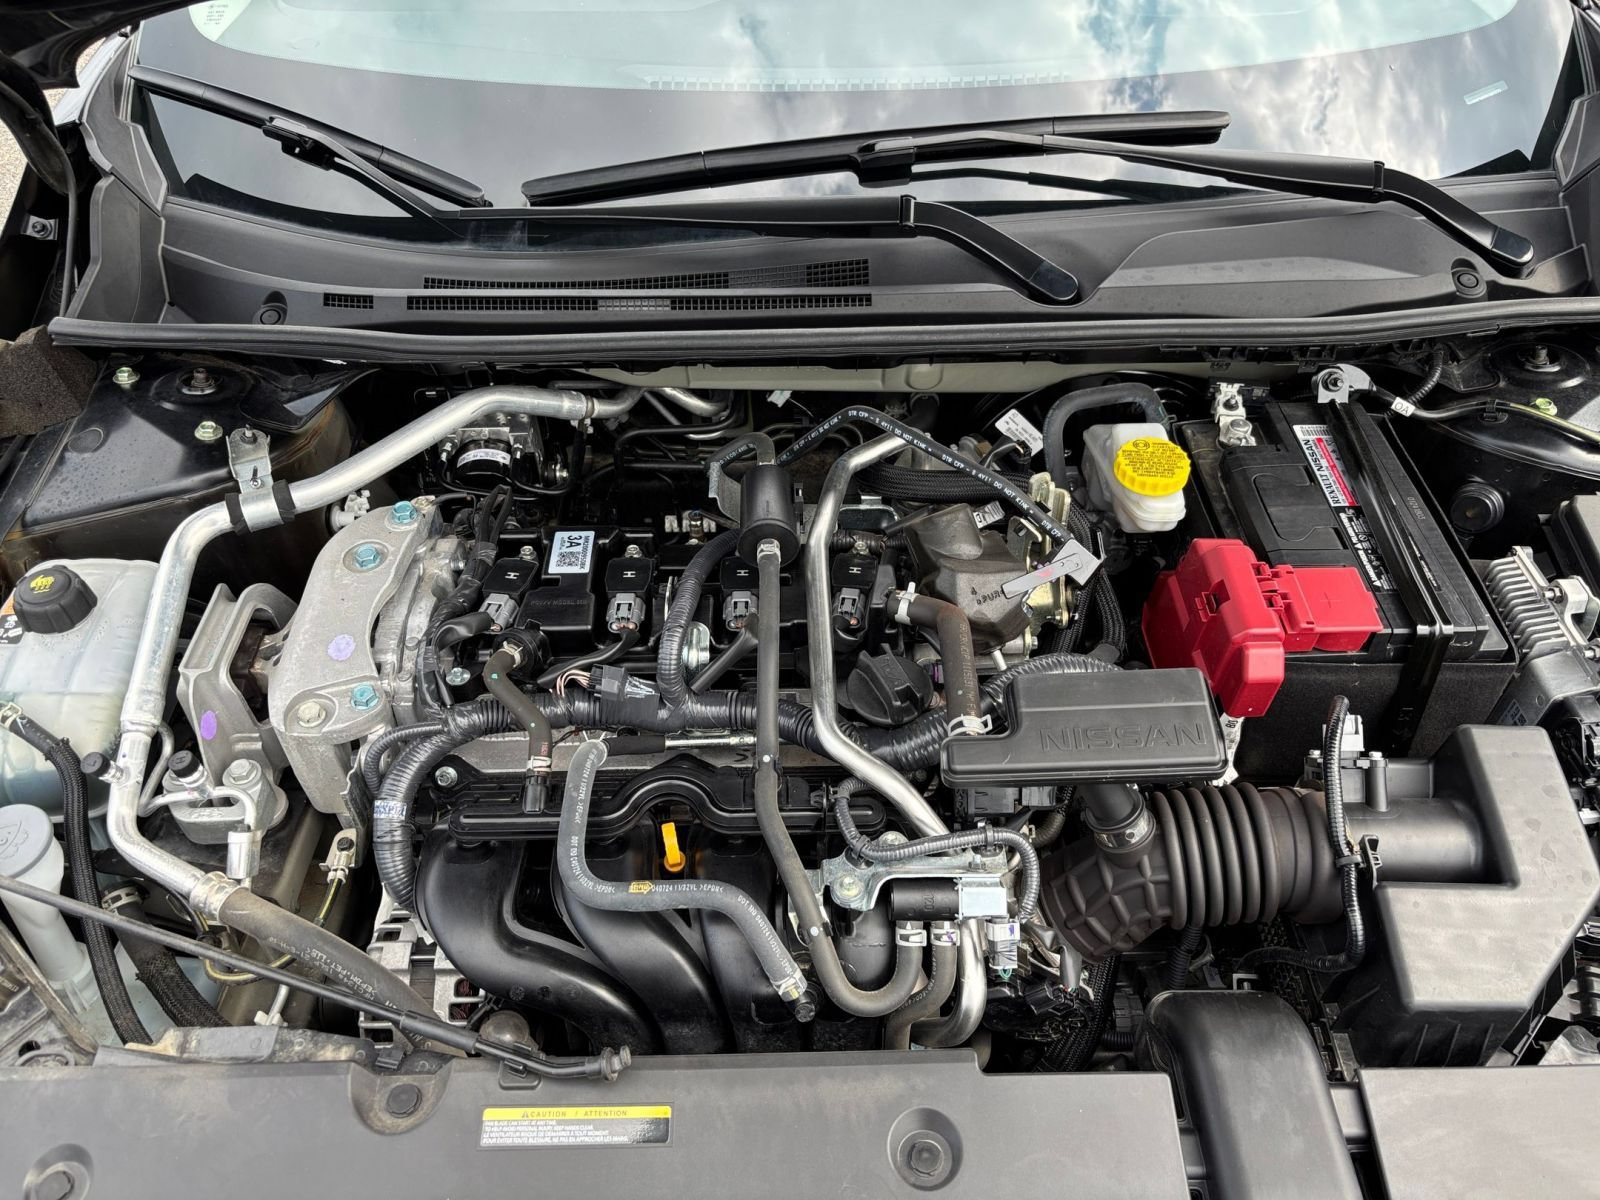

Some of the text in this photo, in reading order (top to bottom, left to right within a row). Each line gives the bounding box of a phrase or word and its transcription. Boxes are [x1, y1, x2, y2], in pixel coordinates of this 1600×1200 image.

[894, 428, 902, 436] DO
[903, 433, 912, 442] NOT
[913, 439, 927, 450] KINK
[1303, 440, 1325, 472] NISSAN
[994, 481, 1002, 489] DO
[1004, 488, 1015, 498] NOT
[1015, 497, 1029, 509] KINK
[1320, 474, 1341, 505] RENAULT
[566, 535, 582, 548] 3A
[1040, 722, 1206, 750] NISSAN
